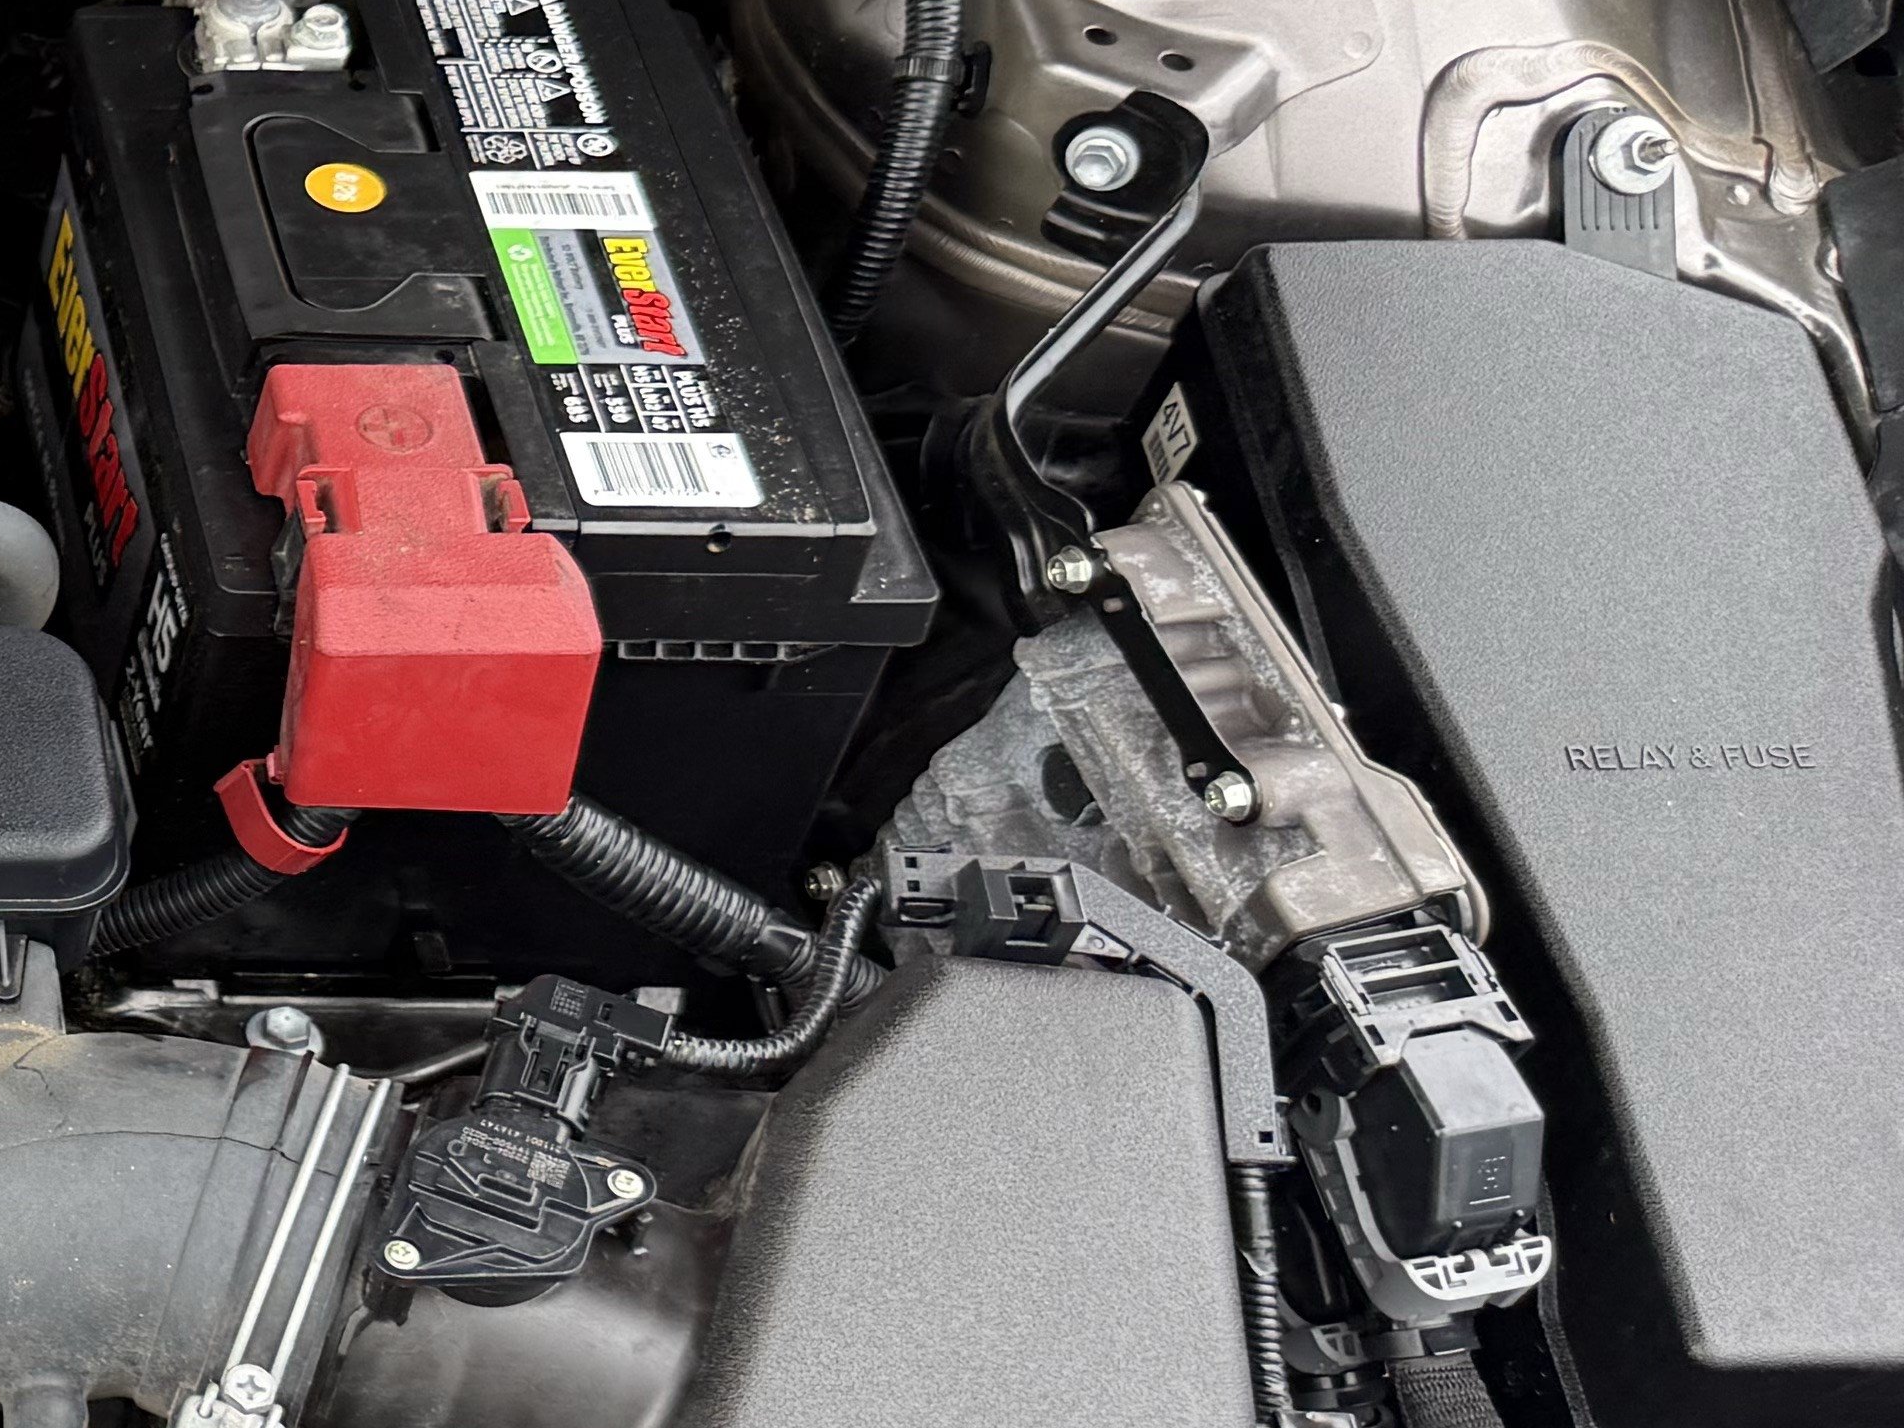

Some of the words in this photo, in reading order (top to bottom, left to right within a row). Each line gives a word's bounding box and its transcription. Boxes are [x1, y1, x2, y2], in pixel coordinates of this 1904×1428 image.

[602, 236, 688, 357] EverStart
[610, 314, 636, 345] PLUS
[49, 208, 138, 568] EverStart
[673, 370, 704, 407] PLUS
[1163, 401, 1191, 458] 4V7
[1565, 744, 1678, 771] RELAY
[1690, 746, 1713, 770] &
[1720, 744, 1818, 769] FUSE
